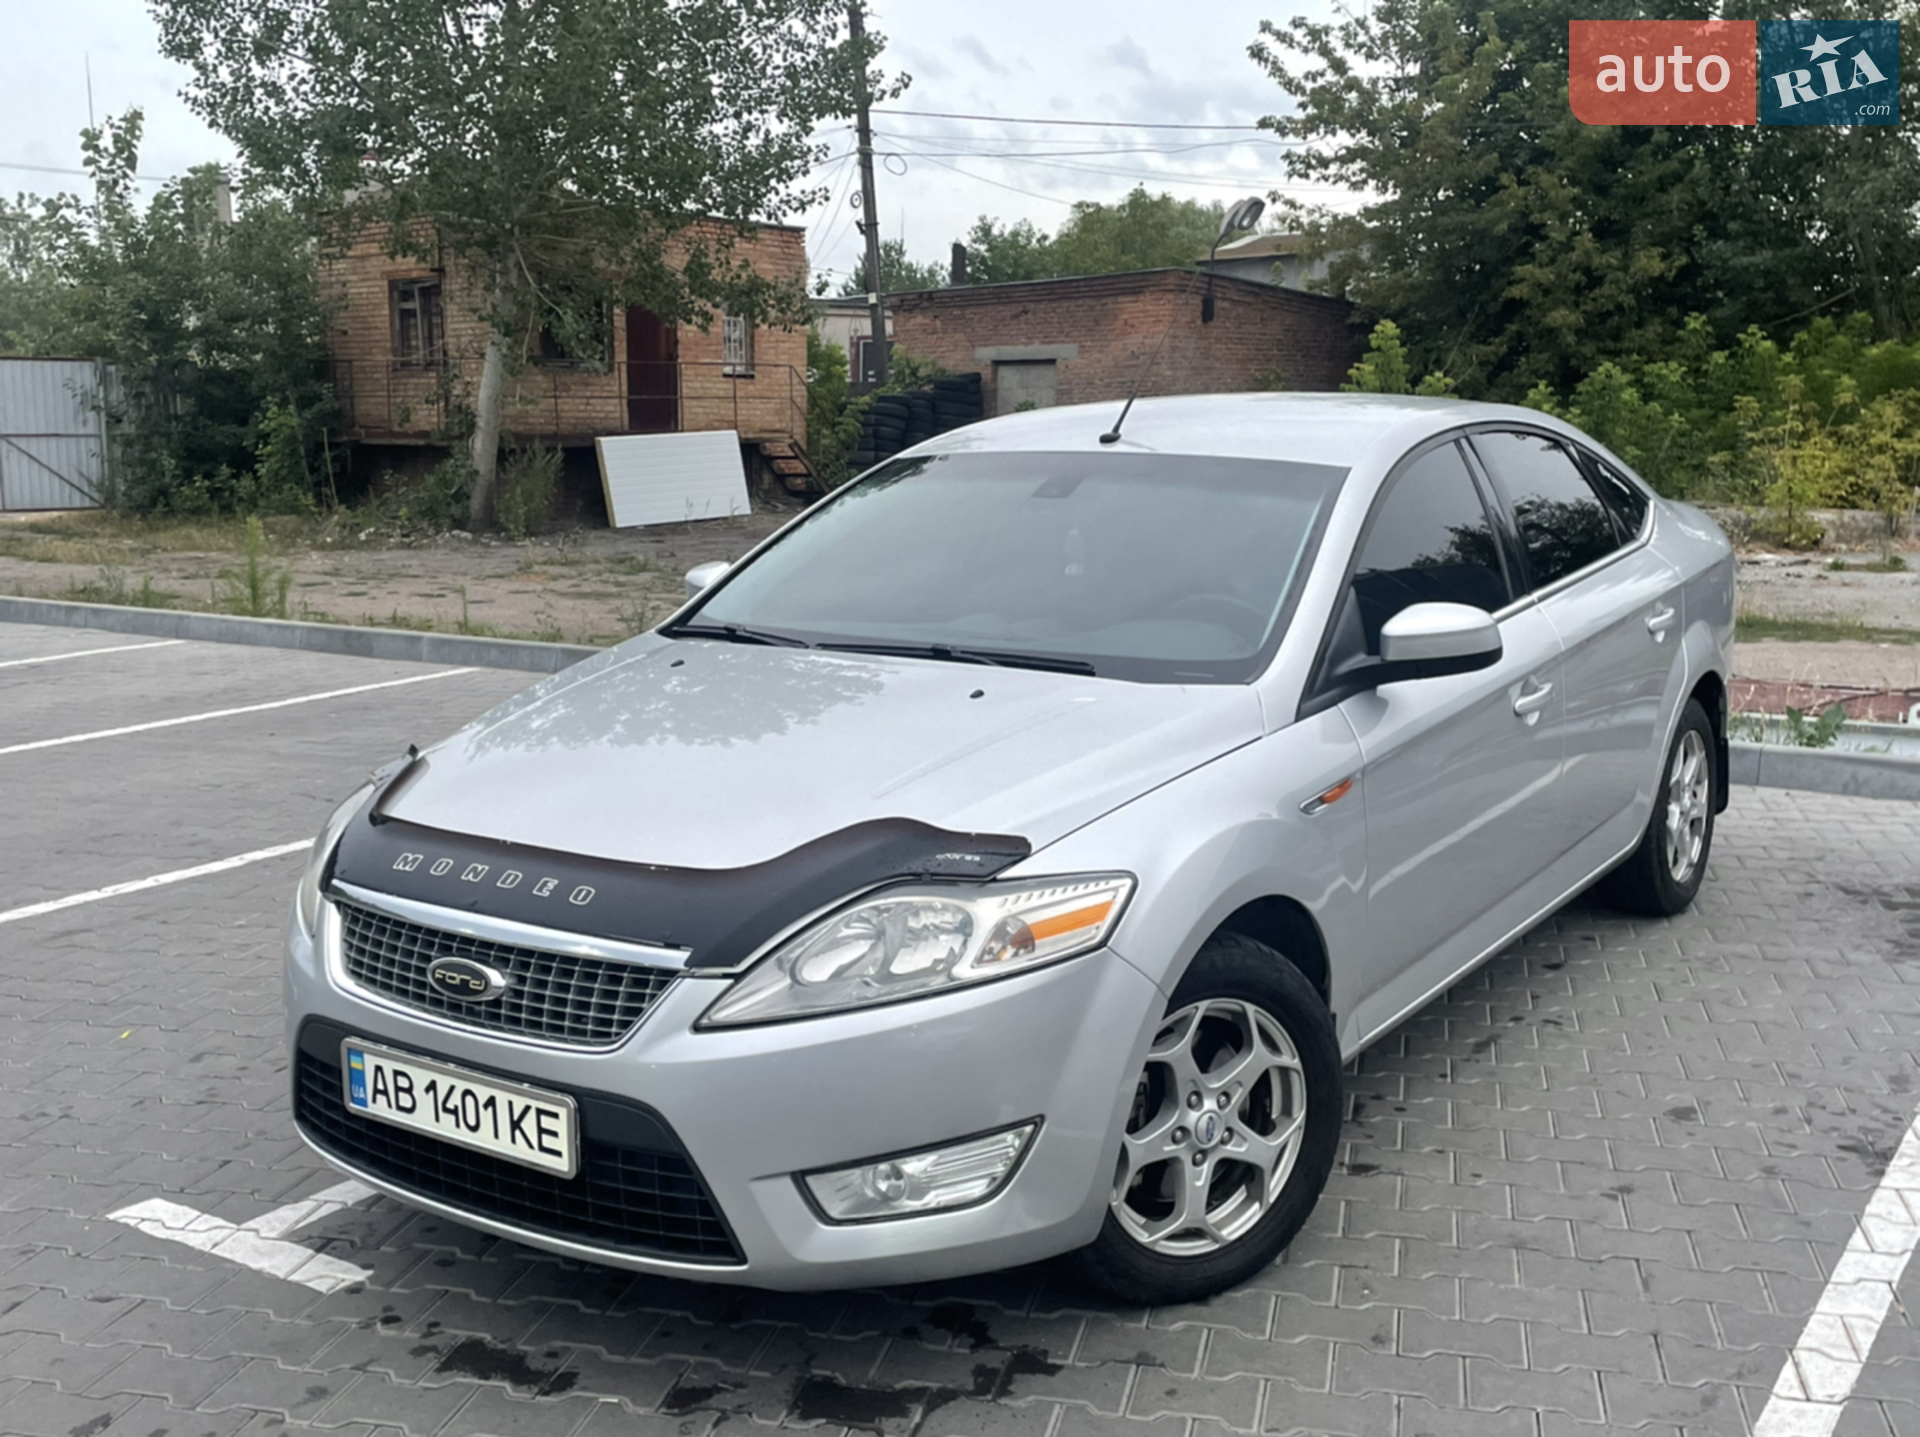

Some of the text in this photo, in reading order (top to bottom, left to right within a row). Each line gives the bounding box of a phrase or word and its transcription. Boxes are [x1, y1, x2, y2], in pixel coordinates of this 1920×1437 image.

[392, 852, 596, 906] MONDEO
[351, 1084, 366, 1100] UA
[371, 1064, 563, 1159] AB 1401 KE
